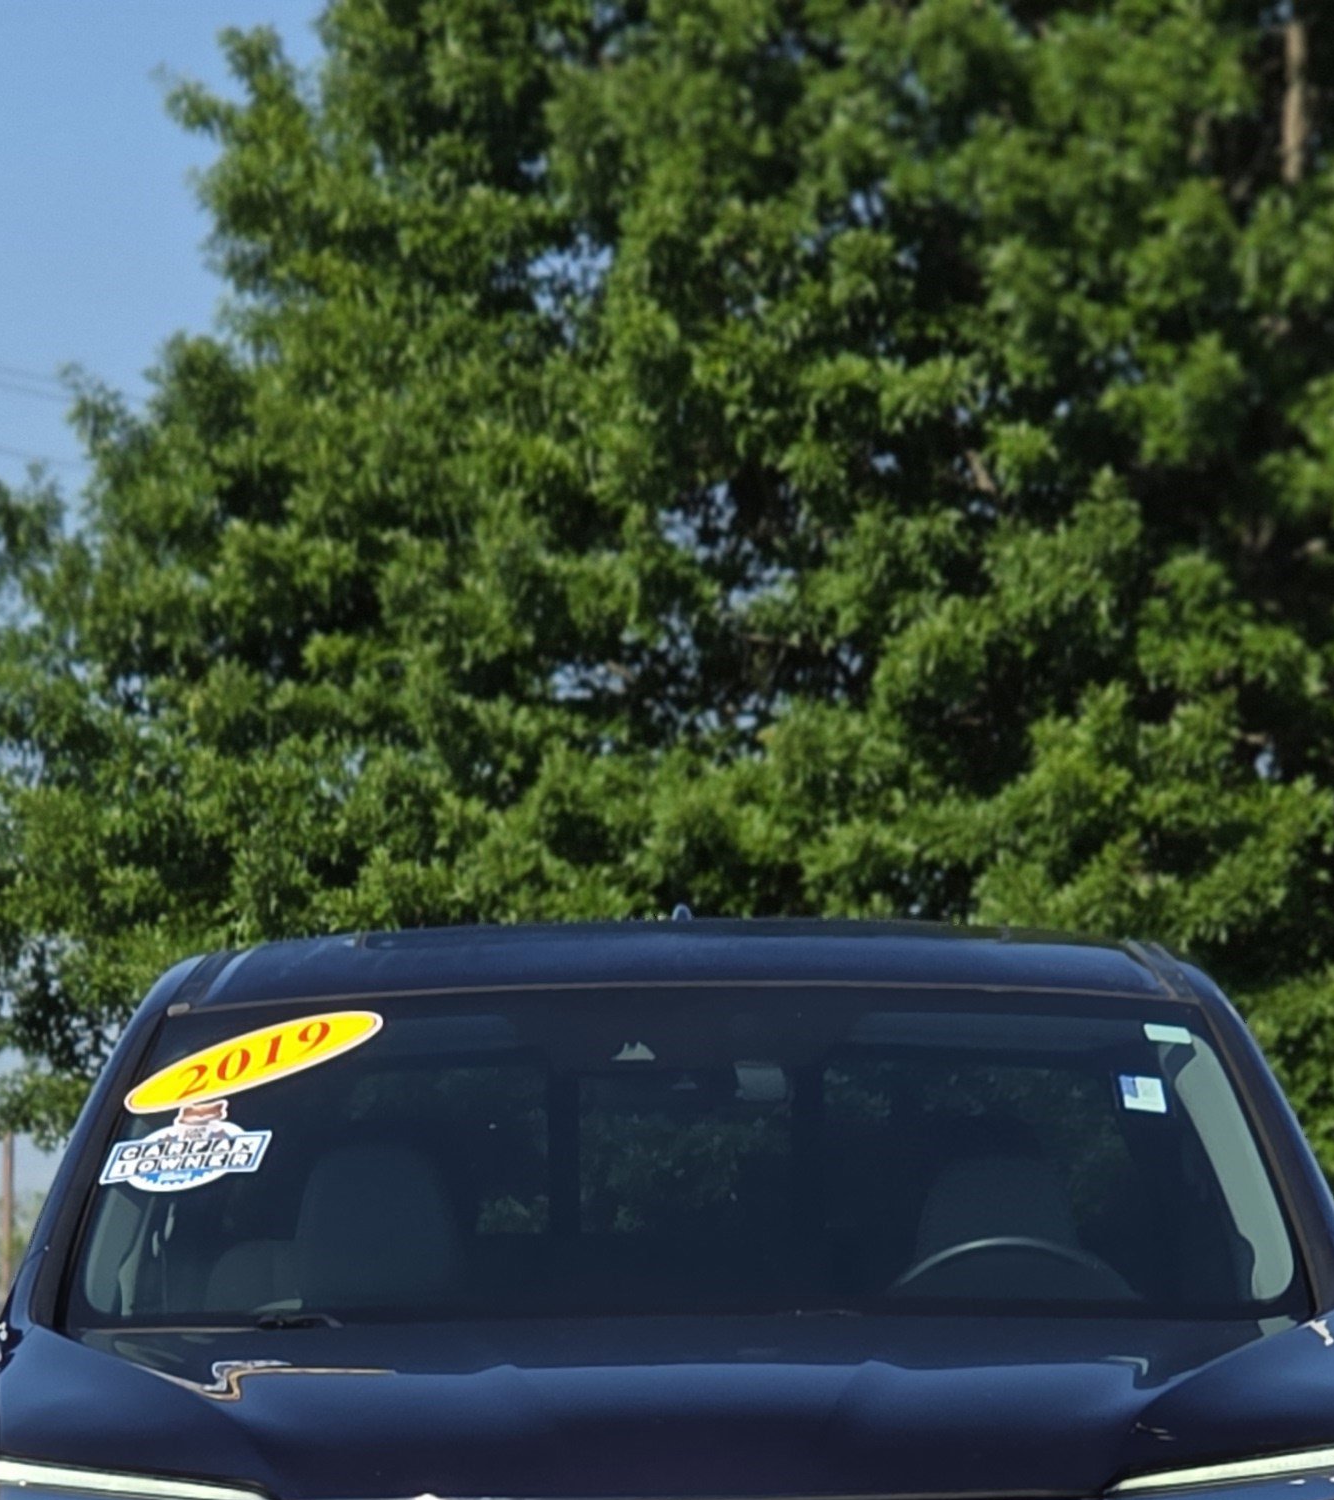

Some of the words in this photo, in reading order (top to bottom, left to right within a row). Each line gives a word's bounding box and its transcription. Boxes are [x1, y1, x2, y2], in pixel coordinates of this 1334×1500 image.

[177, 1020, 331, 1100] 2019
[121, 1139, 255, 1160] CARFAX
[138, 1153, 251, 1173] OWNER
